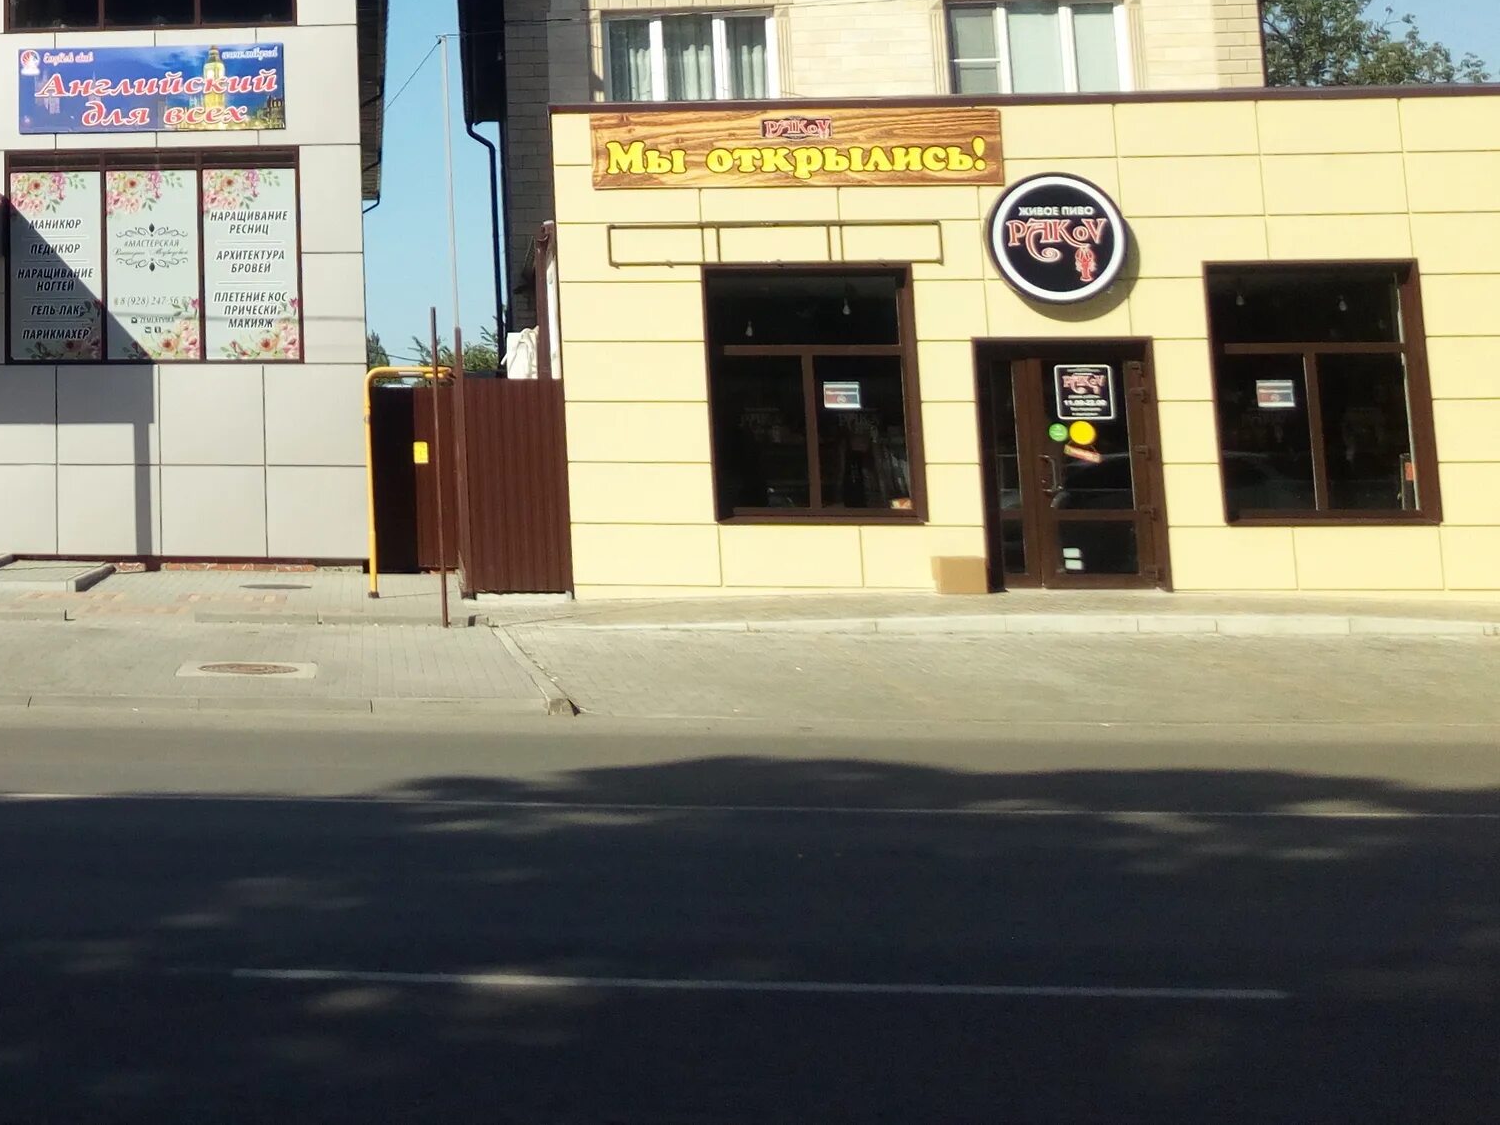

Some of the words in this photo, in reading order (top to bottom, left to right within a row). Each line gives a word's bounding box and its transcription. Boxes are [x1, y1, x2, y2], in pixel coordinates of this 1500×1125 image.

[35, 69, 278, 98] Английский
[82, 101, 150, 127] для
[163, 104, 248, 126] всех
[605, 140, 687, 175] Мы
[705, 136, 987, 180] открылись!
[210, 210, 288, 222] НАРАЩИВАНИЕ
[1018, 206, 1059, 217] ЖИВОЕ
[1060, 205, 1094, 217] ПИВО
[29, 218, 82, 230] МАНИКЮР
[229, 223, 270, 236] РЕСНИЦ
[30, 243, 81, 255] ПЕДИКЮР
[216, 249, 285, 261] АРХИТЕКТУРА
[17, 267, 94, 280] НАРАЩИВАНИЕ
[231, 261, 271, 274] БРОВЕЙ
[36, 278, 75, 292] НОГТЕЙ
[127, 295, 149, 307] (928)
[213, 291, 266, 303] ПЛЕТЕНИЕ
[268, 291, 288, 302] КОС
[228, 318, 275, 328] МАКИЯЖ
[22, 328, 90, 340] ПАРИКМАХЕР
